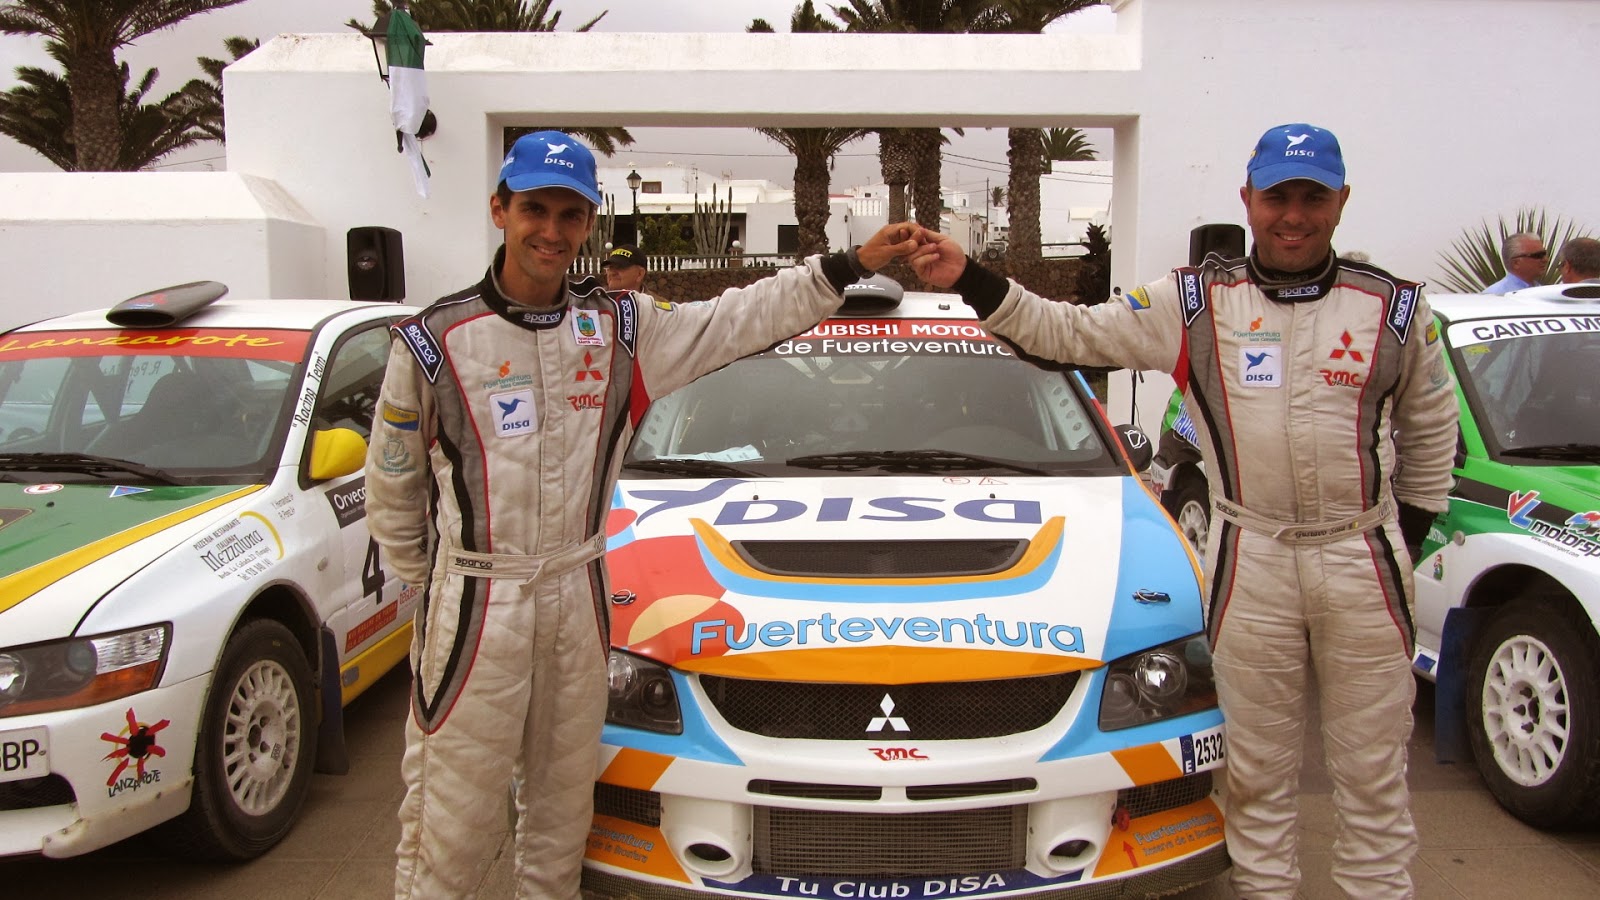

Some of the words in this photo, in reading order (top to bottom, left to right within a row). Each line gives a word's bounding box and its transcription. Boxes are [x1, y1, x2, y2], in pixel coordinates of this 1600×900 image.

[1184, 275, 1199, 310] sparco
[1277, 285, 1319, 297] sparco
[522, 312, 561, 323] sparco
[621, 300, 632, 341] sparco
[1393, 289, 1413, 327] sparco
[0, 334, 284, 351] Lanzarote
[1472, 319, 1566, 341] CANTO
[405, 324, 437, 365] sparco
[774, 340, 812, 354] de
[200, 530, 264, 572] Mezzaluna
[454, 557, 493, 570] sparco
[691, 612, 1086, 655] Fuerteventura
[1195, 732, 1224, 766] 2532
[108, 769, 161, 797] LANZAROTE
[776, 876, 818, 895] Tu
[833, 879, 911, 899] Club
[923, 873, 1006, 897] DISA
